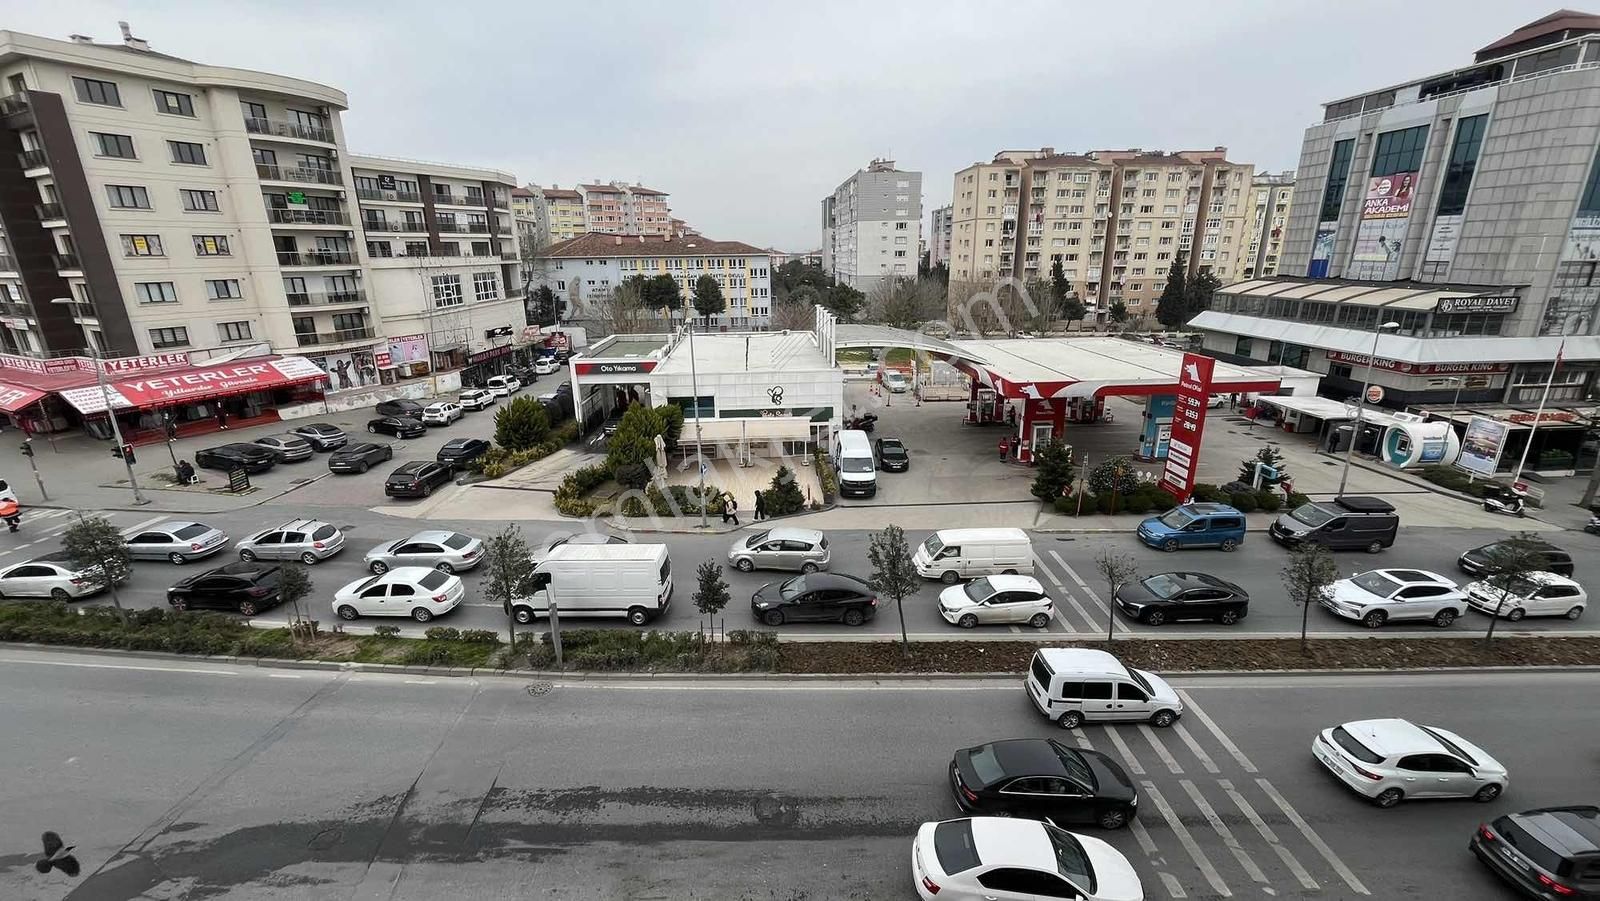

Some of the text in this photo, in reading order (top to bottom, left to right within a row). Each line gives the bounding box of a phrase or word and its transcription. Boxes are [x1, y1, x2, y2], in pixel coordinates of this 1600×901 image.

[1364, 198, 1389, 208] ANKA
[1454, 297, 1516, 306] ROYAL DAVET
[110, 353, 187, 370] YETERLER
[1373, 356, 1396, 368] KING
